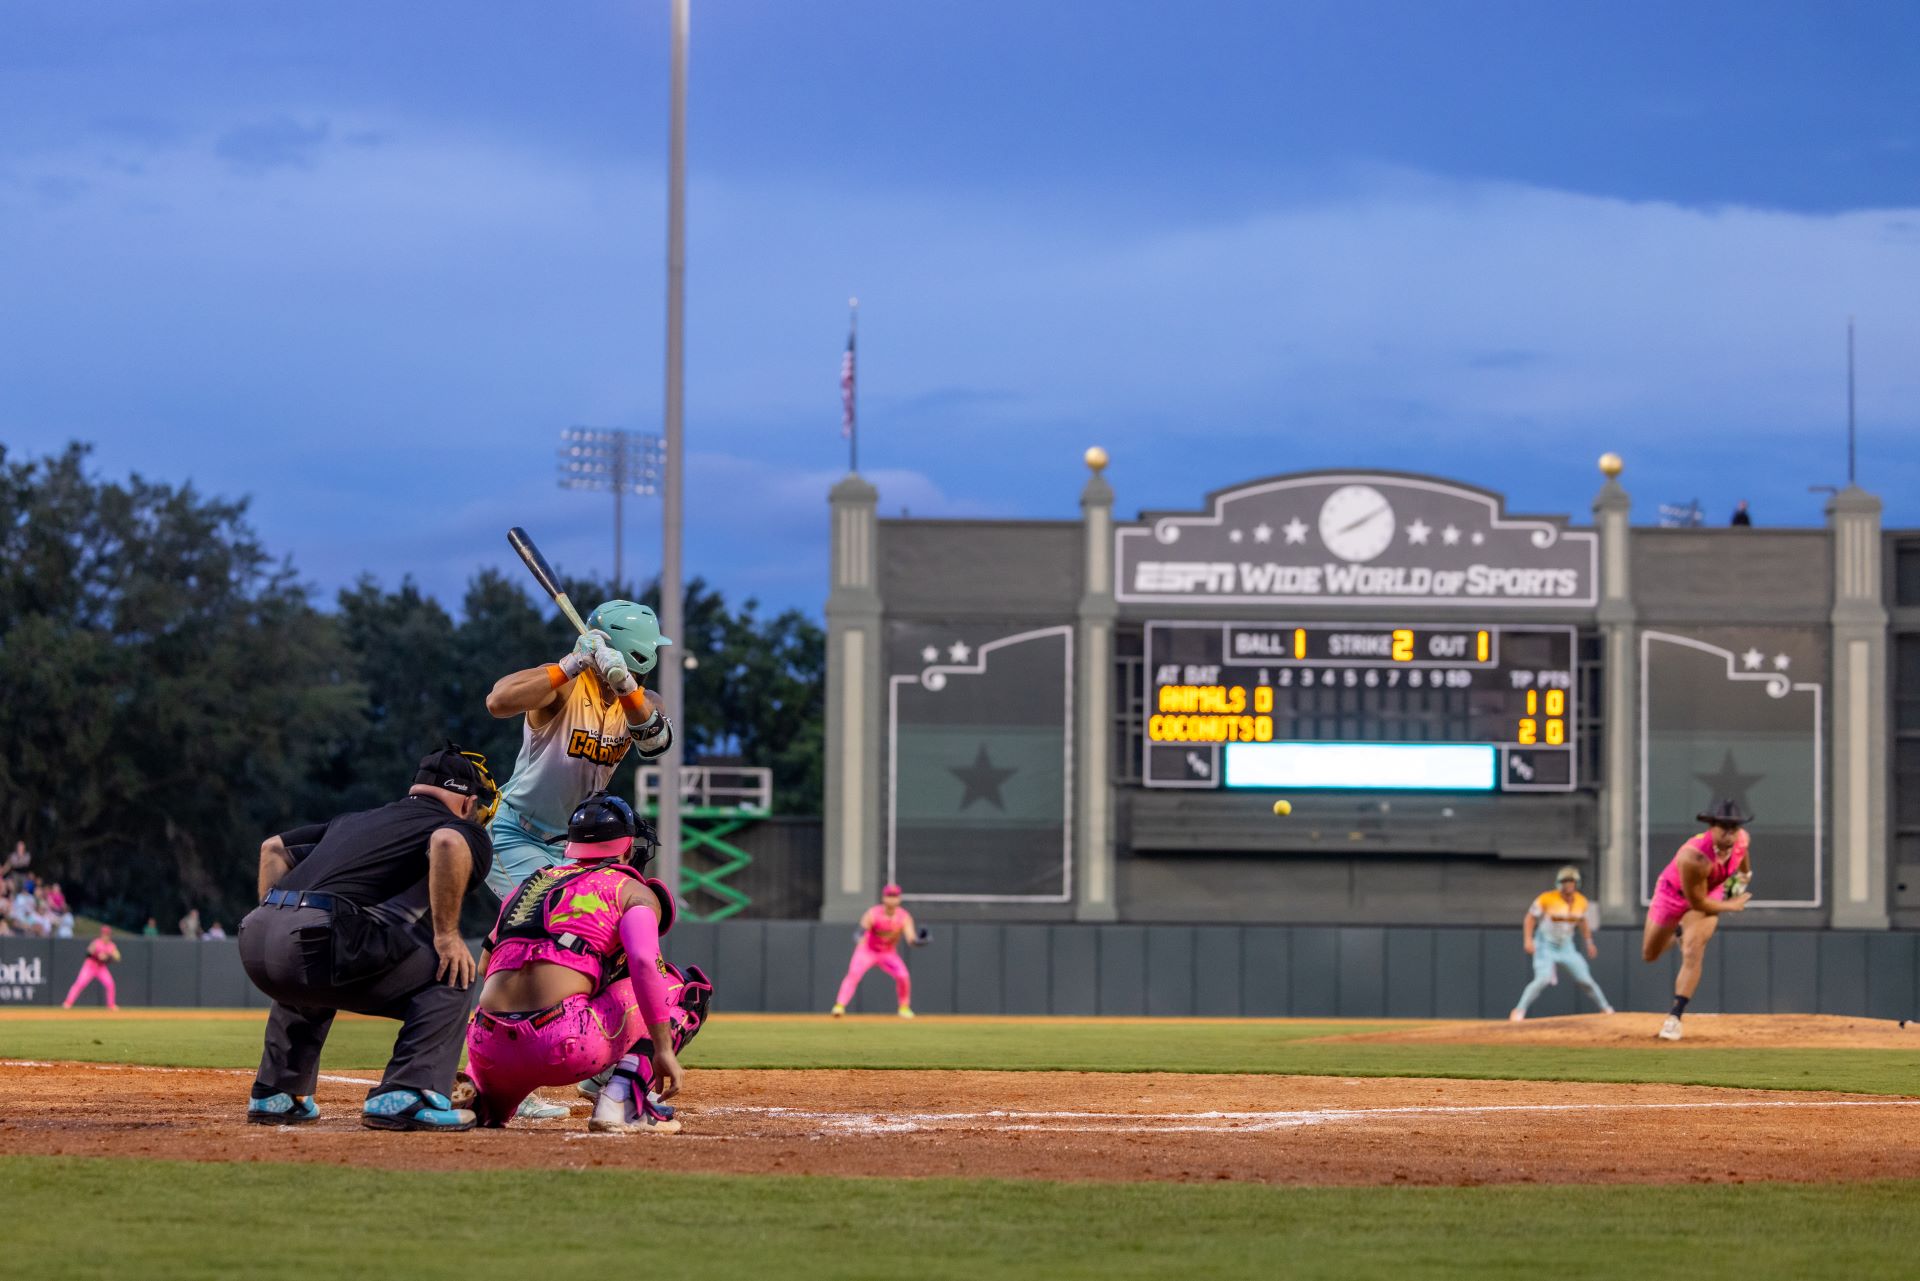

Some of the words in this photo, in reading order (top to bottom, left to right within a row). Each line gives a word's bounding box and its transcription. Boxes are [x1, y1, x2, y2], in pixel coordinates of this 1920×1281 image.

[1134, 561, 1236, 592] ESPN
[1239, 562, 1322, 594] WIDE
[1324, 563, 1432, 595] WORLD
[1465, 563, 1578, 597] SPORTS
[1235, 632, 1285, 655] BALL
[1294, 627, 1306, 660] 1
[1328, 633, 1393, 656] STRIKE
[1392, 629, 1414, 662] 2
[1428, 634, 1468, 657] OUT
[1477, 630, 1489, 662] 1
[1259, 667, 1270, 686] 1
[1278, 667, 1293, 687] 2
[1300, 667, 1315, 687] 3
[1321, 668, 1336, 687] 4
[1343, 668, 1358, 688] 5
[1364, 668, 1379, 688] 6
[1386, 668, 1400, 688] 7
[1408, 669, 1423, 688] 8
[1429, 669, 1444, 688] 9
[1254, 686, 1274, 713] 0
[1526, 689, 1537, 715] 1
[1545, 689, 1564, 716] 0
[1149, 714, 1255, 742] COCONUTS
[1518, 718, 1537, 745] 2
[1545, 718, 1564, 745] 0
[0, 956, 41, 985] orld
